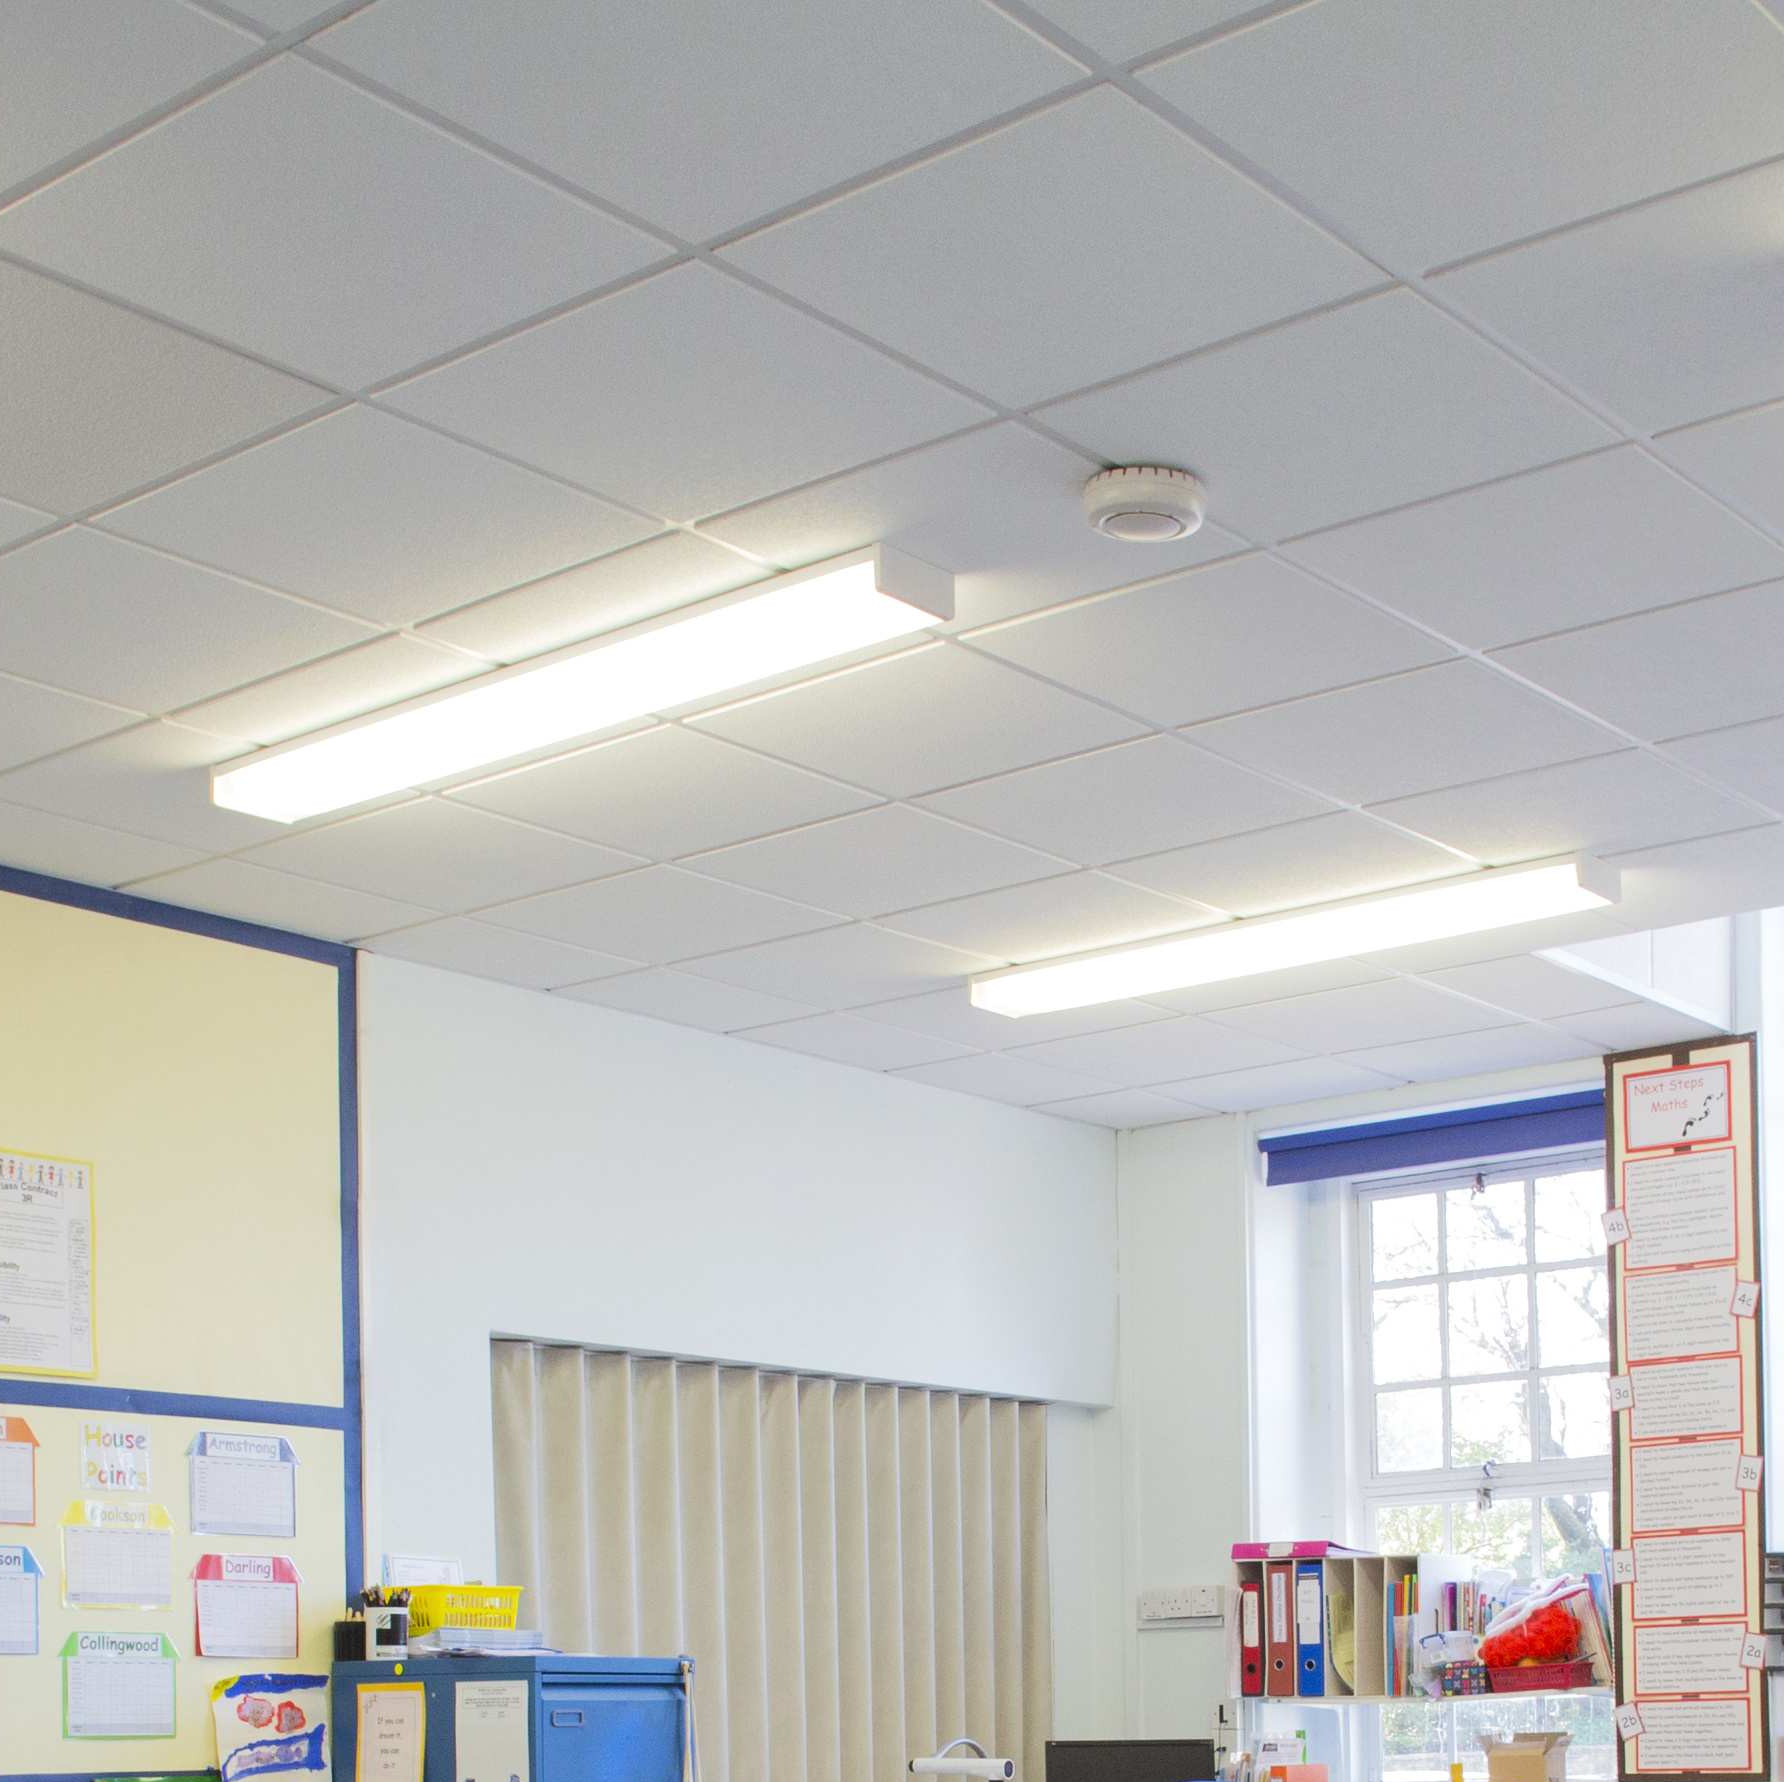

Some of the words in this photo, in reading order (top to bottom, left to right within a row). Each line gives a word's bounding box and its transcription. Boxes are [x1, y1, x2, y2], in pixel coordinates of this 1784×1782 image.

[1633, 1081, 1664, 1096] Next
[1669, 1077, 1704, 1092] Steps
[1650, 1099, 1688, 1114] Maths
[20, 1182, 58, 1199] Contract
[1608, 1221, 1624, 1233] 4b
[1738, 1293, 1753, 1307] 4c
[1614, 1387, 1629, 1400] 3a
[84, 1424, 147, 1450] House
[208, 1437, 278, 1458] Armstrong
[85, 1460, 148, 1487] Points
[1742, 1466, 1757, 1480] 3b
[224, 1558, 271, 1579] Darling
[1616, 1561, 1631, 1574] 3c
[79, 1634, 159, 1655] Collingwood
[1746, 1645, 1761, 1659] 2a
[1621, 1715, 1637, 1728] 2b
